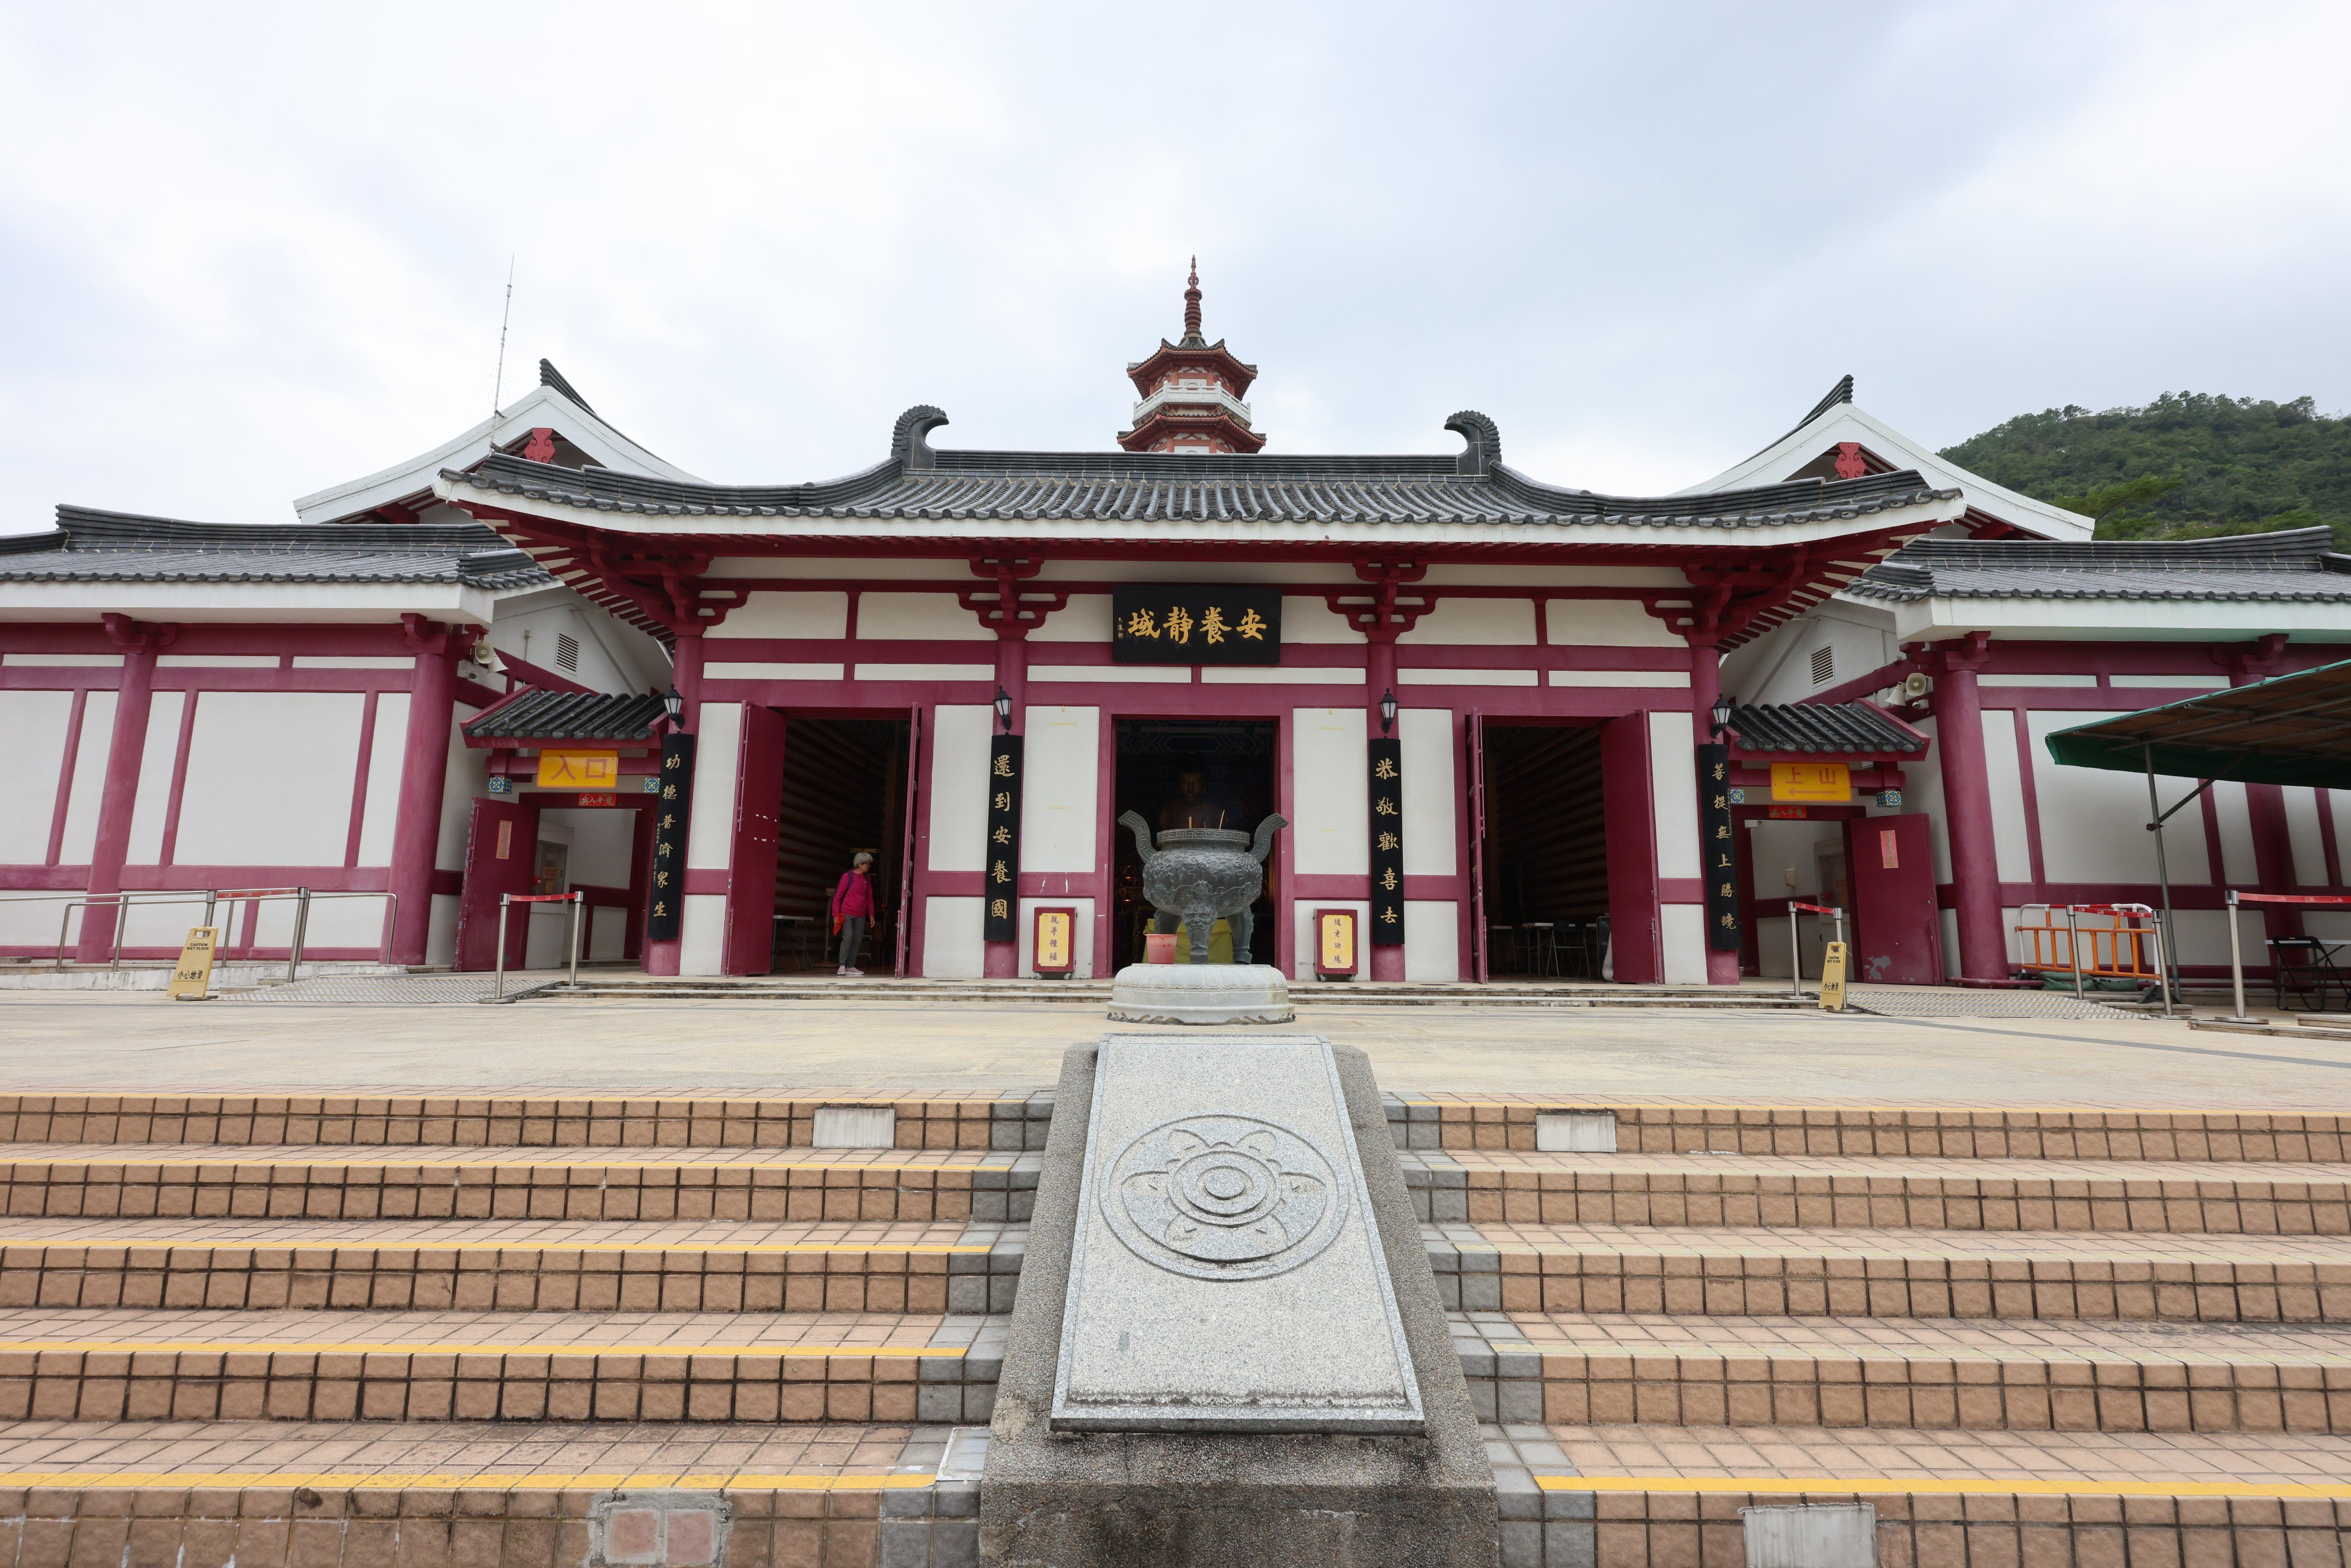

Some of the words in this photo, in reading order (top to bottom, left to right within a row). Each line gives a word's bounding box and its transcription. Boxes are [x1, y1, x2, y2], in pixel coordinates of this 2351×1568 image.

[551, 755, 607, 781] 入口
[1785, 766, 1836, 785] 上山
[581, 795, 614, 804] 出入平安
[1771, 808, 1804, 817] 出入平安
[991, 754, 1015, 919] 還到安養國
[1375, 758, 1399, 923] 恭敬歡喜去
[1712, 763, 1736, 929] 菩提無上勝境
[177, 970, 203, 980] 小心地滑
